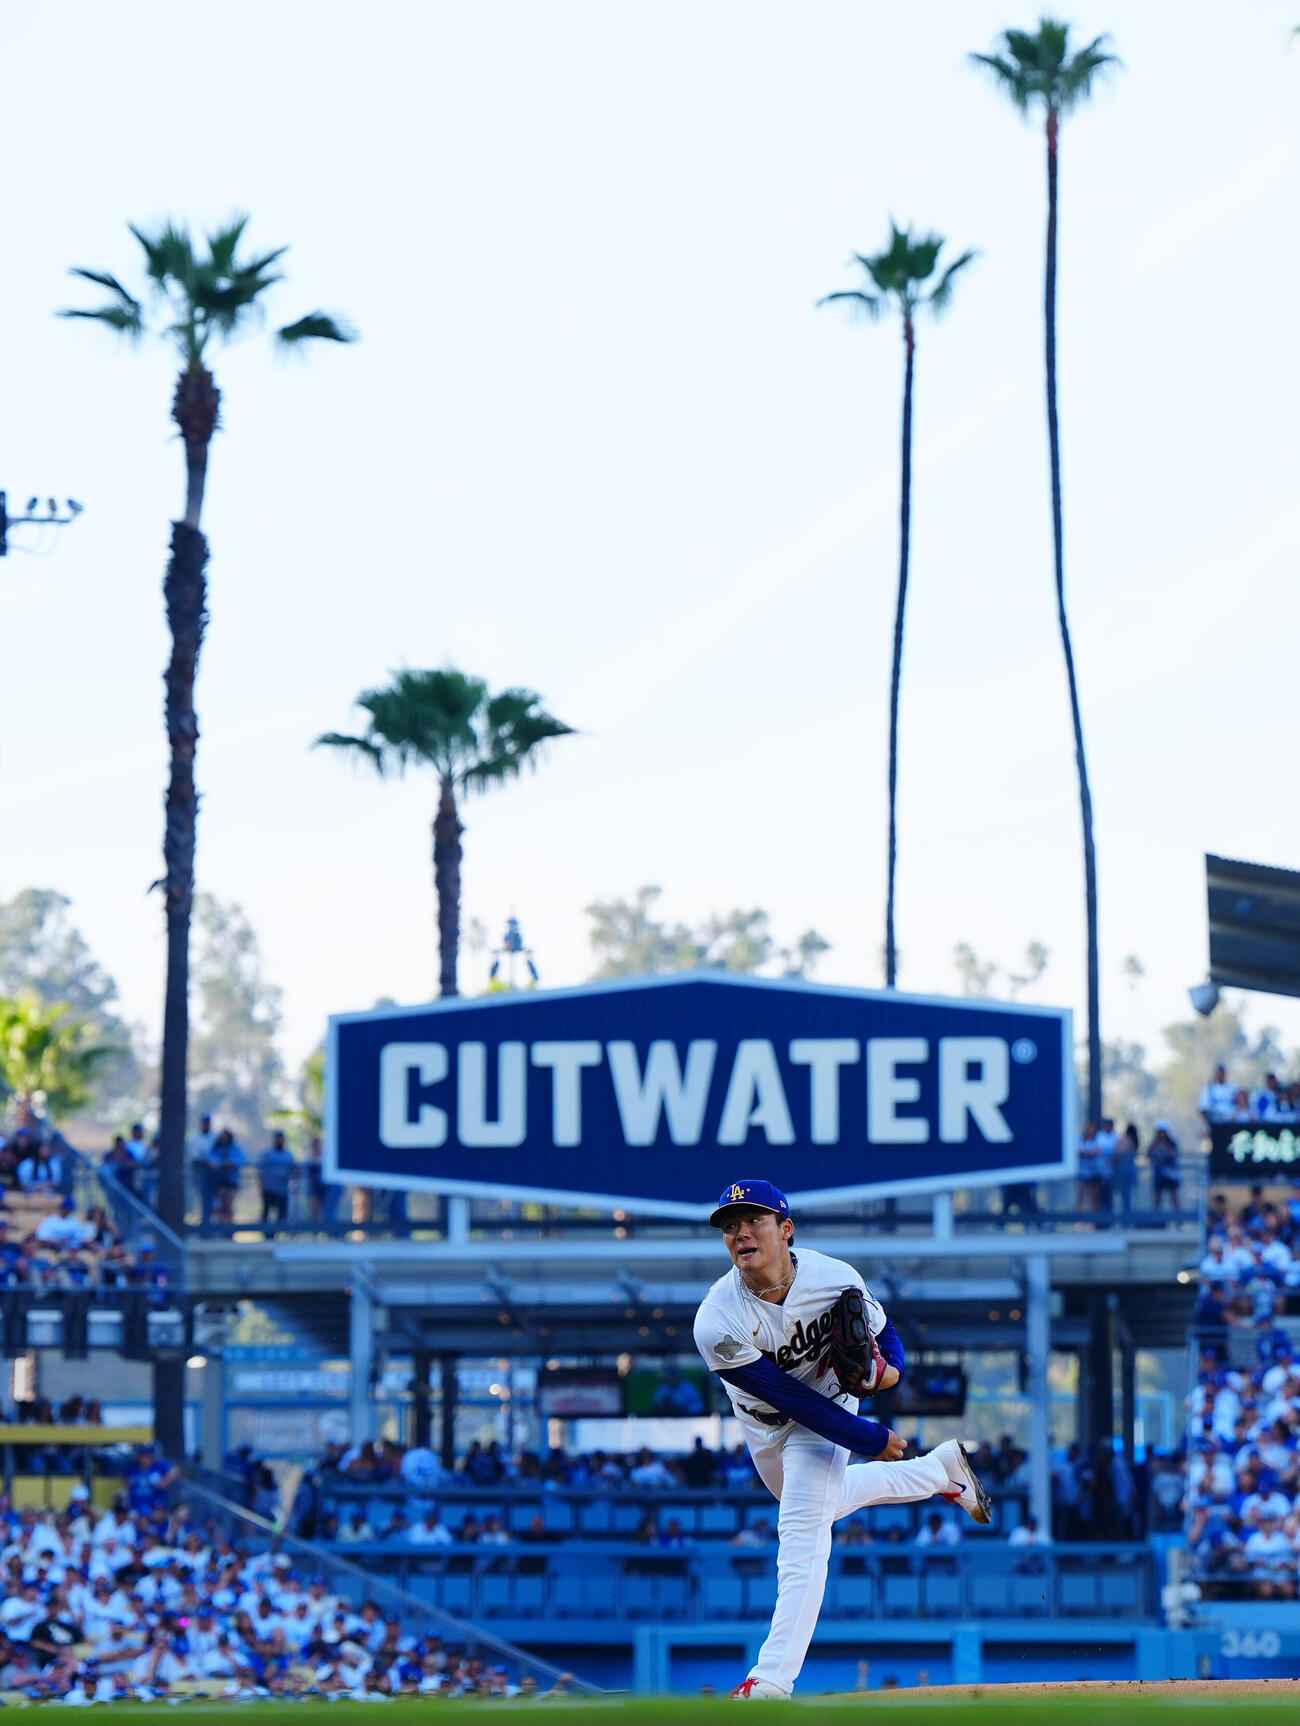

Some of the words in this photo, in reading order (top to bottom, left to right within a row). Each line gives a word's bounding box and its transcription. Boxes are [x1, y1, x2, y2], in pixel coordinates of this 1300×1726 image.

[379, 1037, 1013, 1148] CUTWATER
[730, 1184, 745, 1201] LA
[1221, 1629, 1281, 1658] 360
